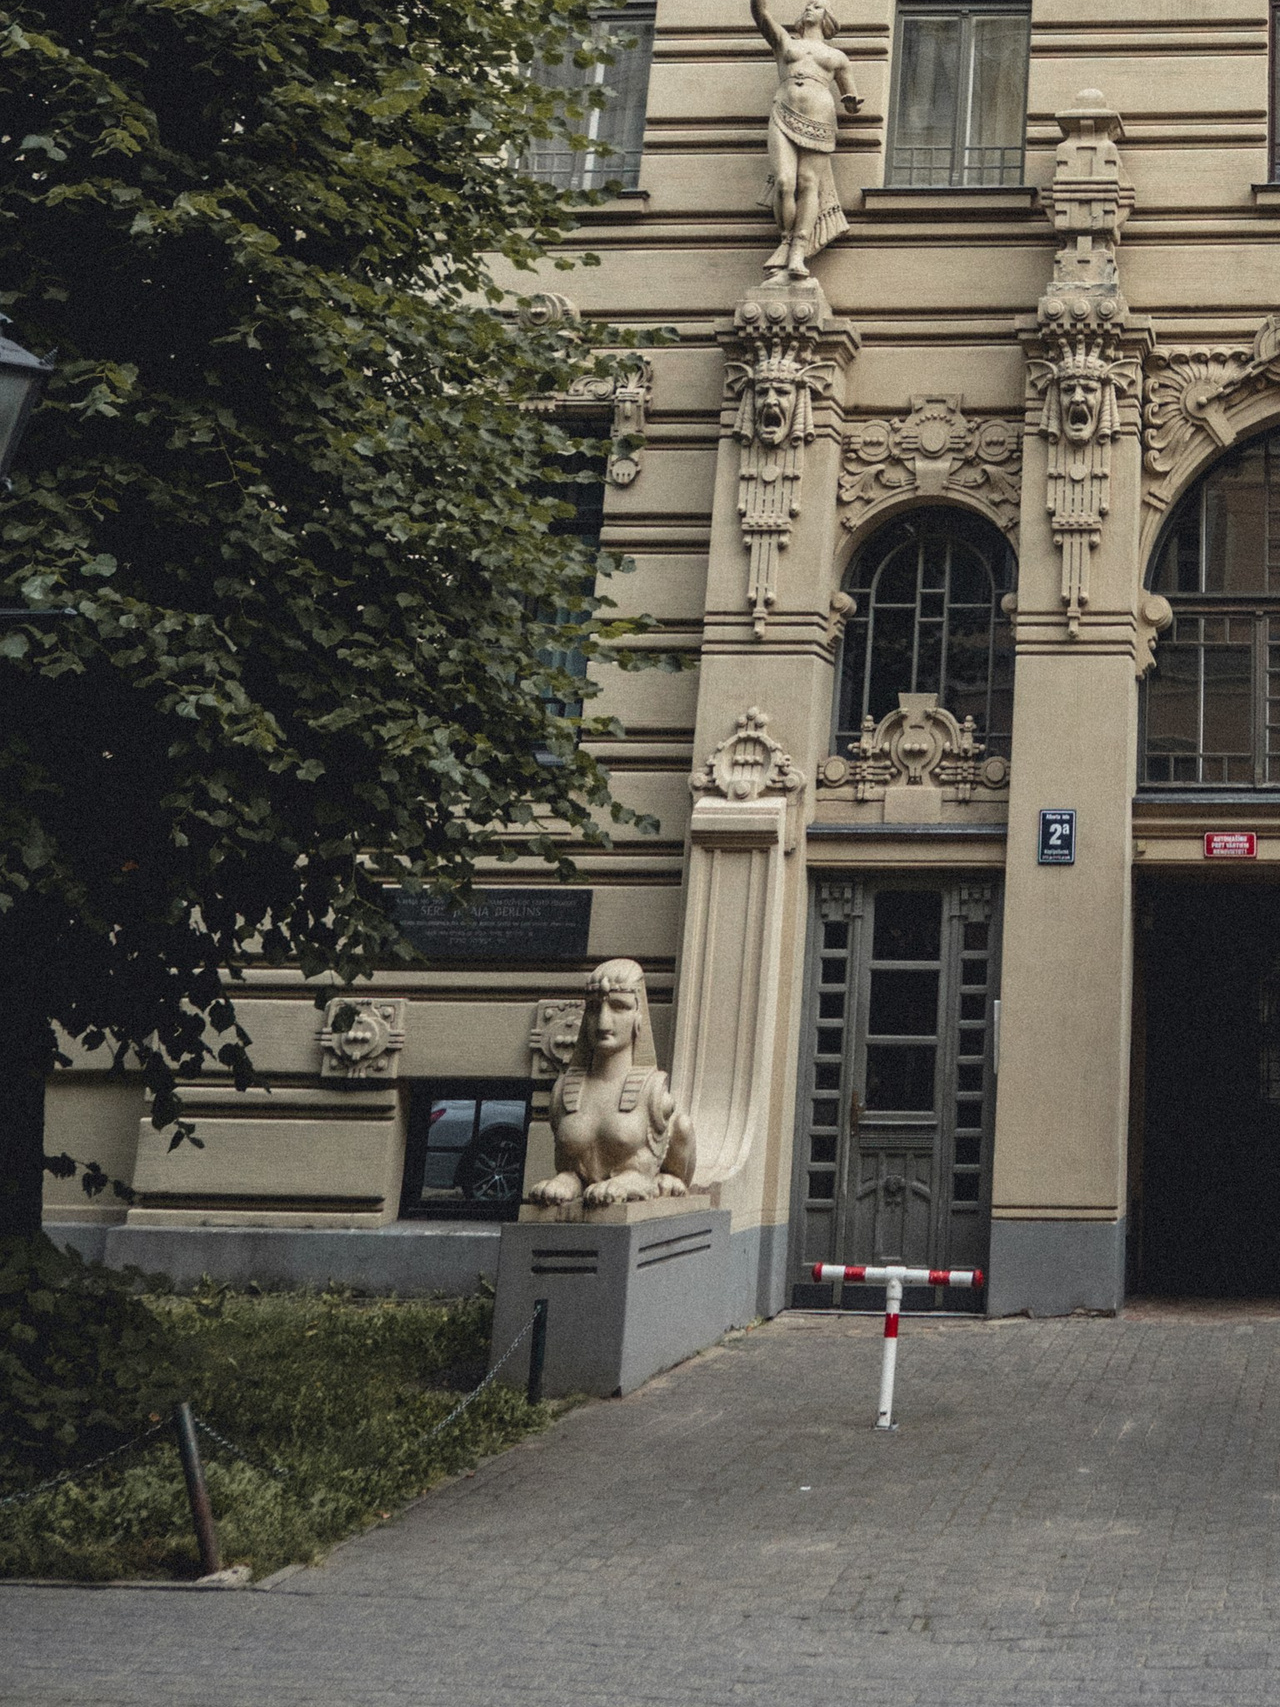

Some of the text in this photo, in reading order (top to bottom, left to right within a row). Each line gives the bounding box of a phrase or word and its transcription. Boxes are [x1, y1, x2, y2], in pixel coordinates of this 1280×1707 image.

[1049, 823, 1070, 845] 2a
[453, 906, 489, 917] JAJA
[494, 906, 542, 917] BERLINS
